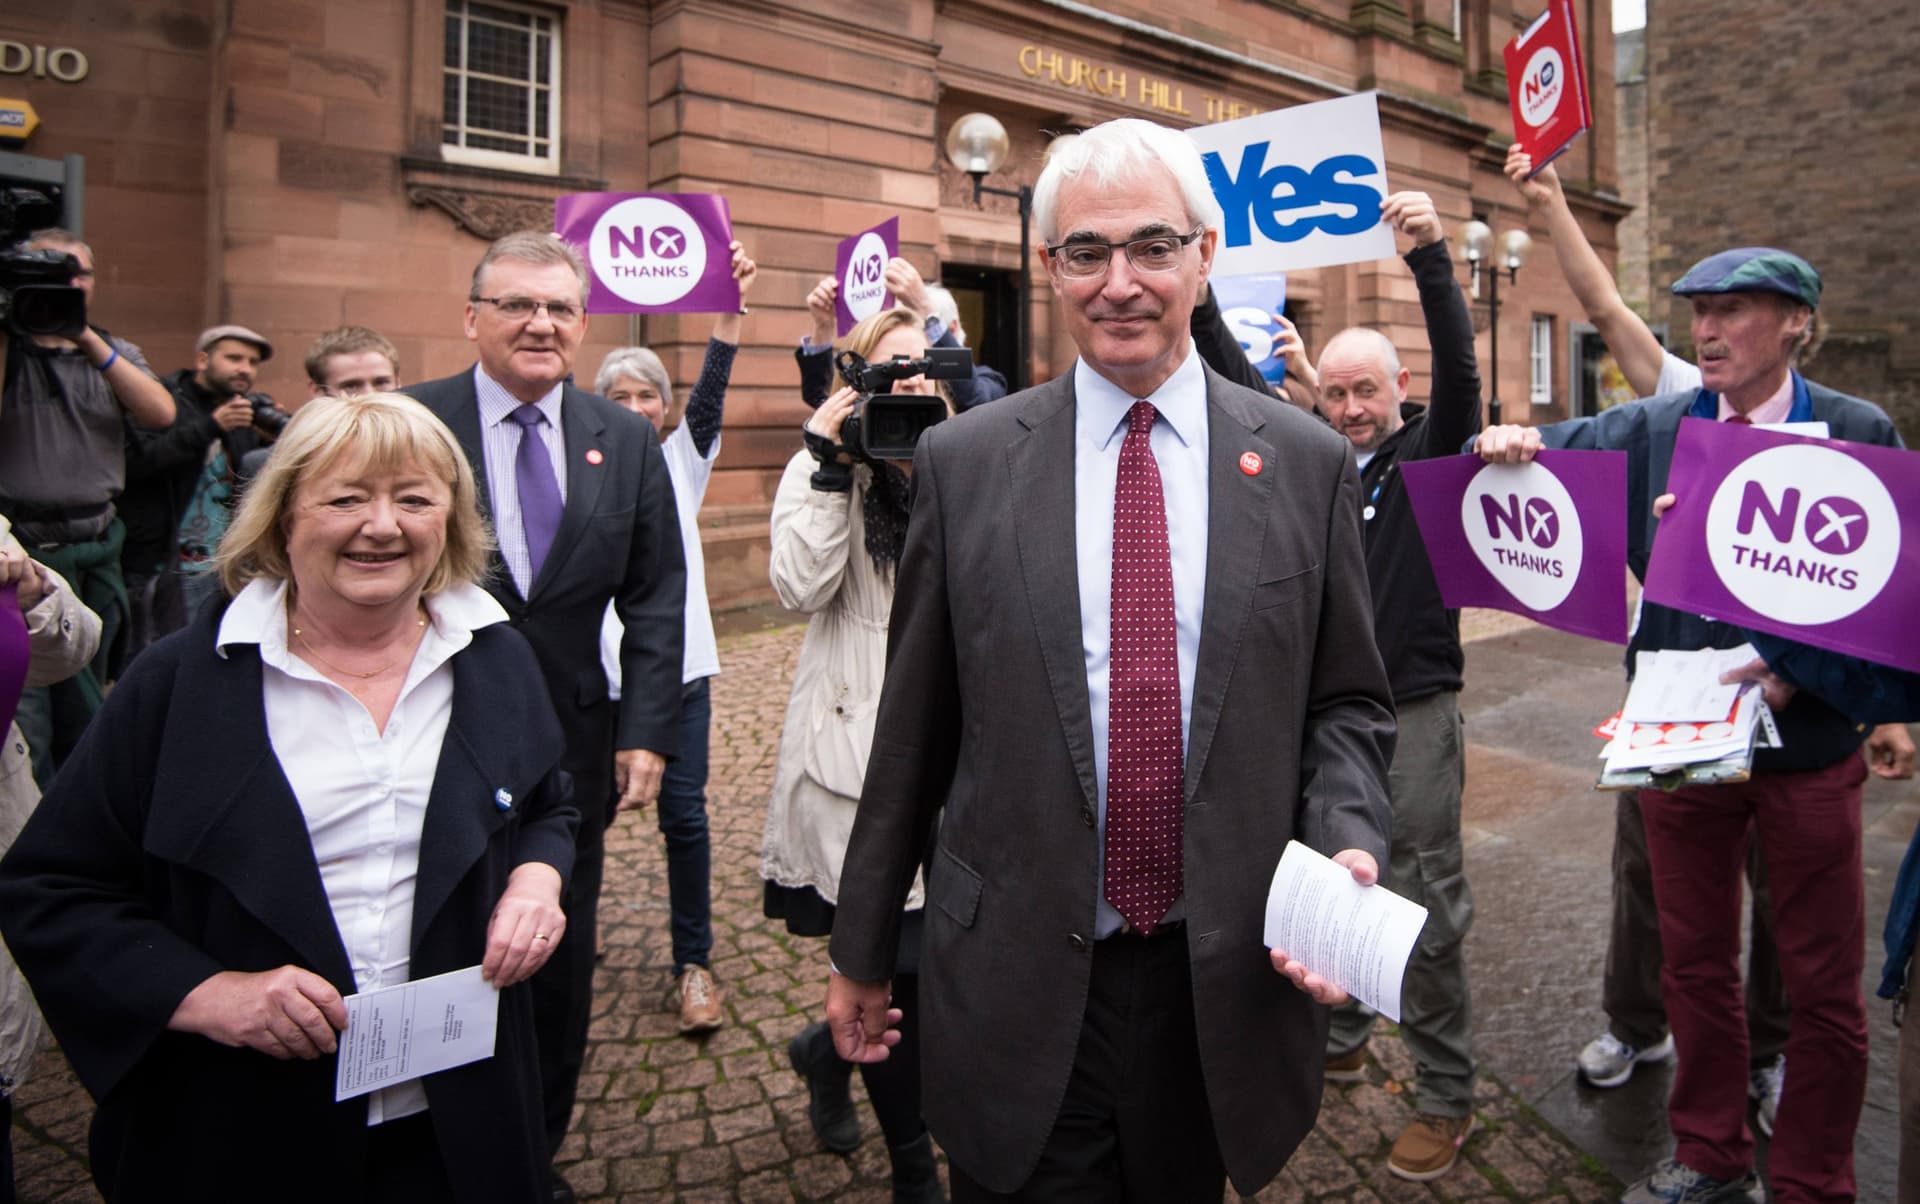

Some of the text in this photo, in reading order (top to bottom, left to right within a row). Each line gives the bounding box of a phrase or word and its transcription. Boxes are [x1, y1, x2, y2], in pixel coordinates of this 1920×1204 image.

[1018, 45, 1262, 121] CHURCH HILL THE
[1525, 62, 1555, 103] NO
[1200, 141, 1382, 248] Yes
[609, 226, 686, 259] NO
[611, 265, 689, 277] THANKS
[852, 254, 881, 288] NO
[851, 287, 882, 303] THANKS
[1480, 494, 1559, 549] NO
[1736, 480, 1869, 555] NO
[1493, 548, 1563, 578] THANKS
[1732, 545, 1859, 590] THANKS
